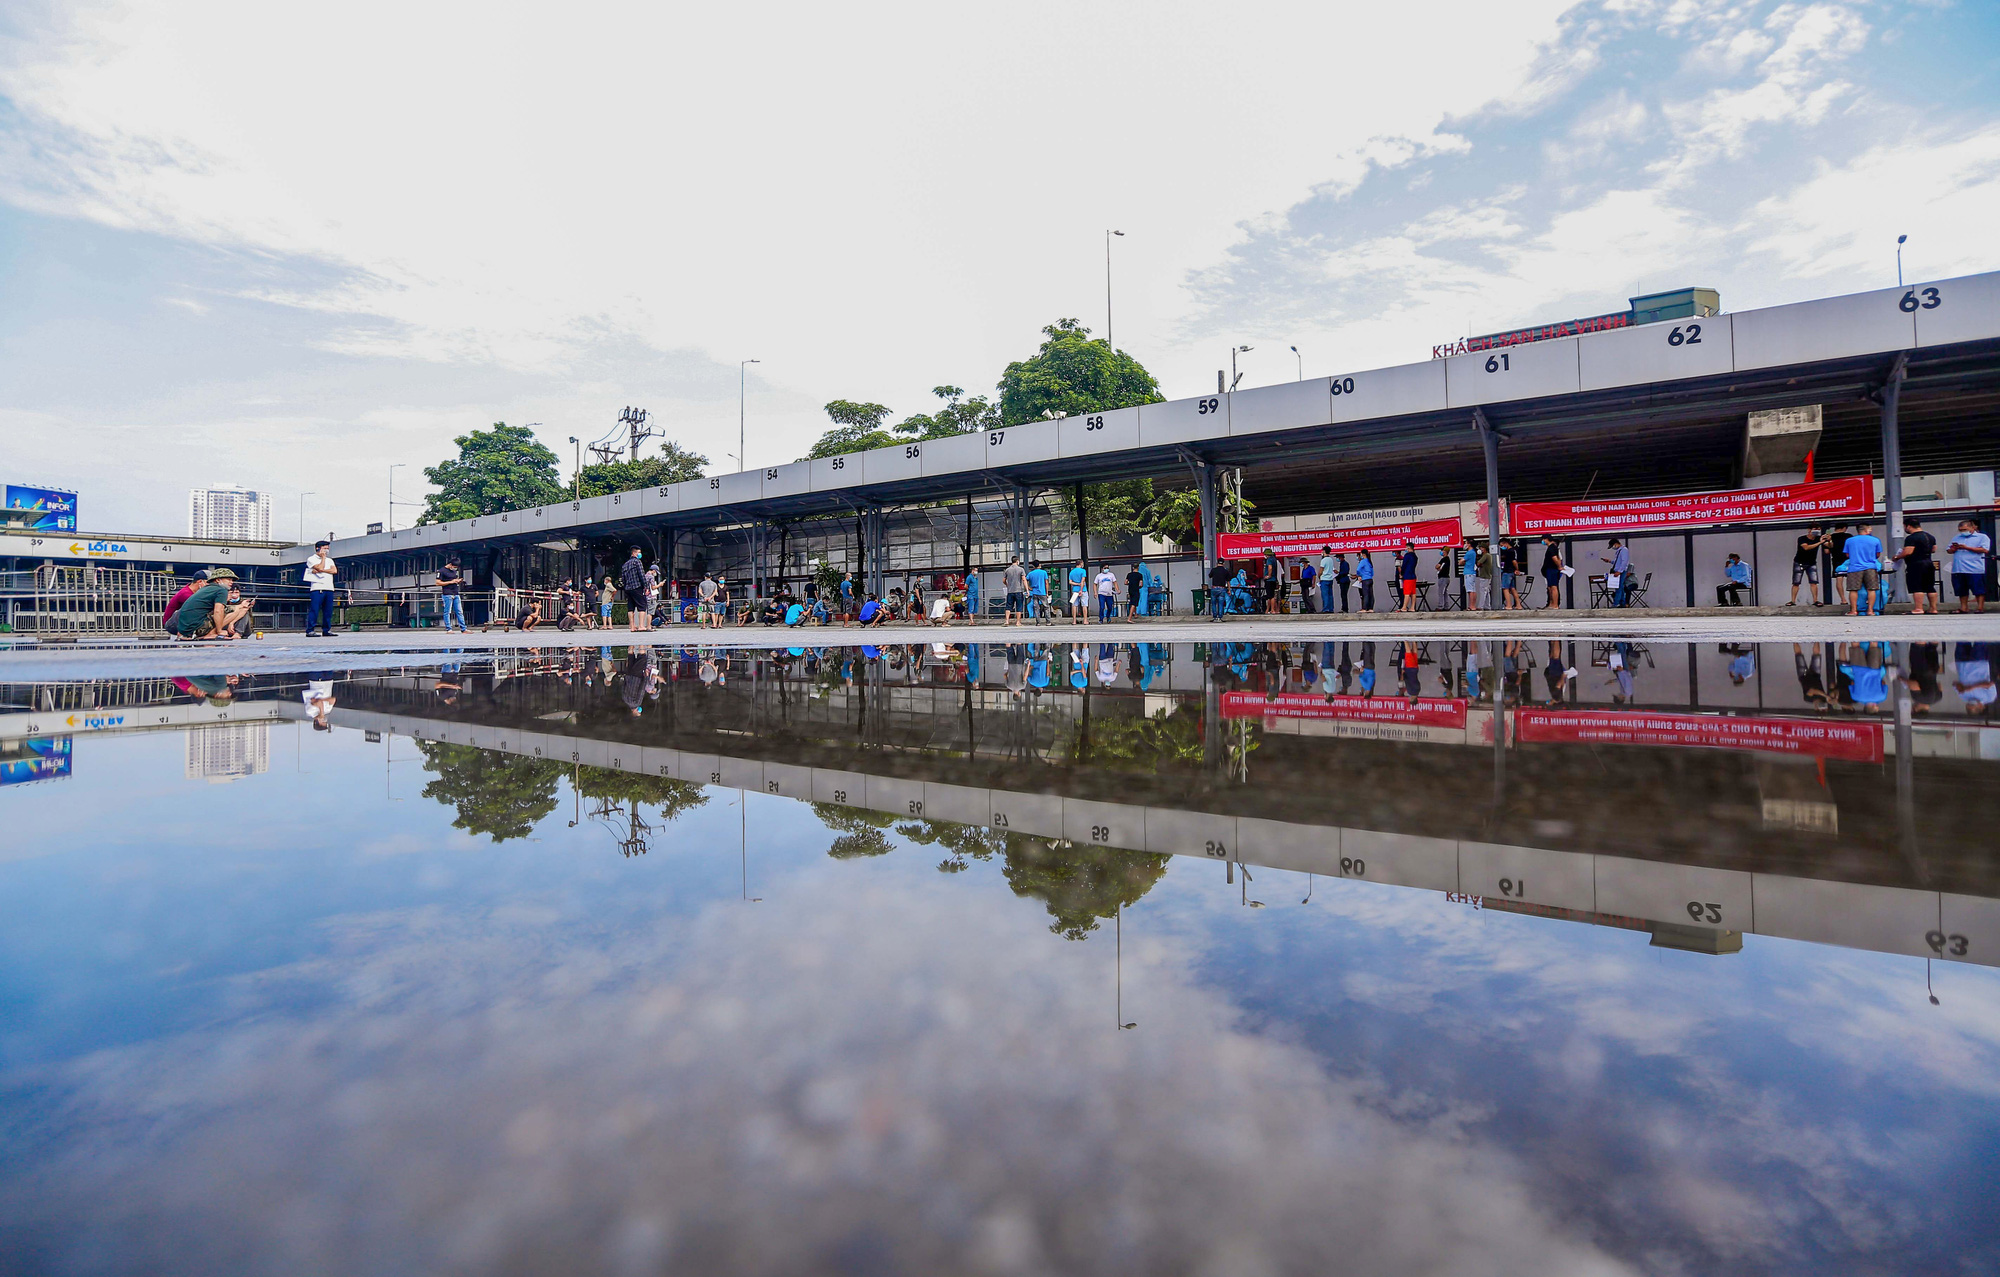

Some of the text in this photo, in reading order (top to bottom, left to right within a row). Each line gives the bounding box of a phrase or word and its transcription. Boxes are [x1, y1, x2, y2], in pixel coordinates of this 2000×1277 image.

[1898, 287, 1941, 312] 63
[1432, 337, 1492, 358] KHÁCH
[1500, 329, 1534, 348] SẠN
[1574, 314, 1626, 334] VINH
[1668, 324, 1702, 346] 62
[1485, 354, 1509, 373] 61
[1330, 377, 1354, 396] 60
[1198, 398, 1219, 414] 59
[1086, 416, 1104, 431] 58
[990, 432, 1004, 445] 57
[906, 446, 919, 458] 56
[832, 458, 844, 470] 55
[767, 469, 778, 480] 54
[710, 479, 719, 489] 53
[660, 488, 668, 497] 52
[614, 495, 621, 504] 51
[1572, 506, 1589, 514] BỆNH
[1592, 504, 1606, 512] VIỆN
[1701, 496, 1709, 504] TẾ
[1731, 494, 1756, 502] THÔNG
[1758, 492, 1774, 501] VẬN
[1776, 489, 1789, 498] TẢI
[535, 508, 542, 517] 49
[573, 503, 580, 511] 50
[502, 514, 507, 522] 48
[1525, 520, 1542, 529] TEST
[1574, 516, 1602, 526] KHÁNG
[1604, 515, 1638, 524] NGUYÊN
[1640, 514, 1665, 522] VIRUS
[1668, 510, 1721, 520] SARS-CoV-2
[1724, 508, 1742, 516] CHO
[1745, 505, 1760, 515] LÁI
[1763, 505, 1775, 513] XE
[88, 540, 127, 552] LỐI RA
